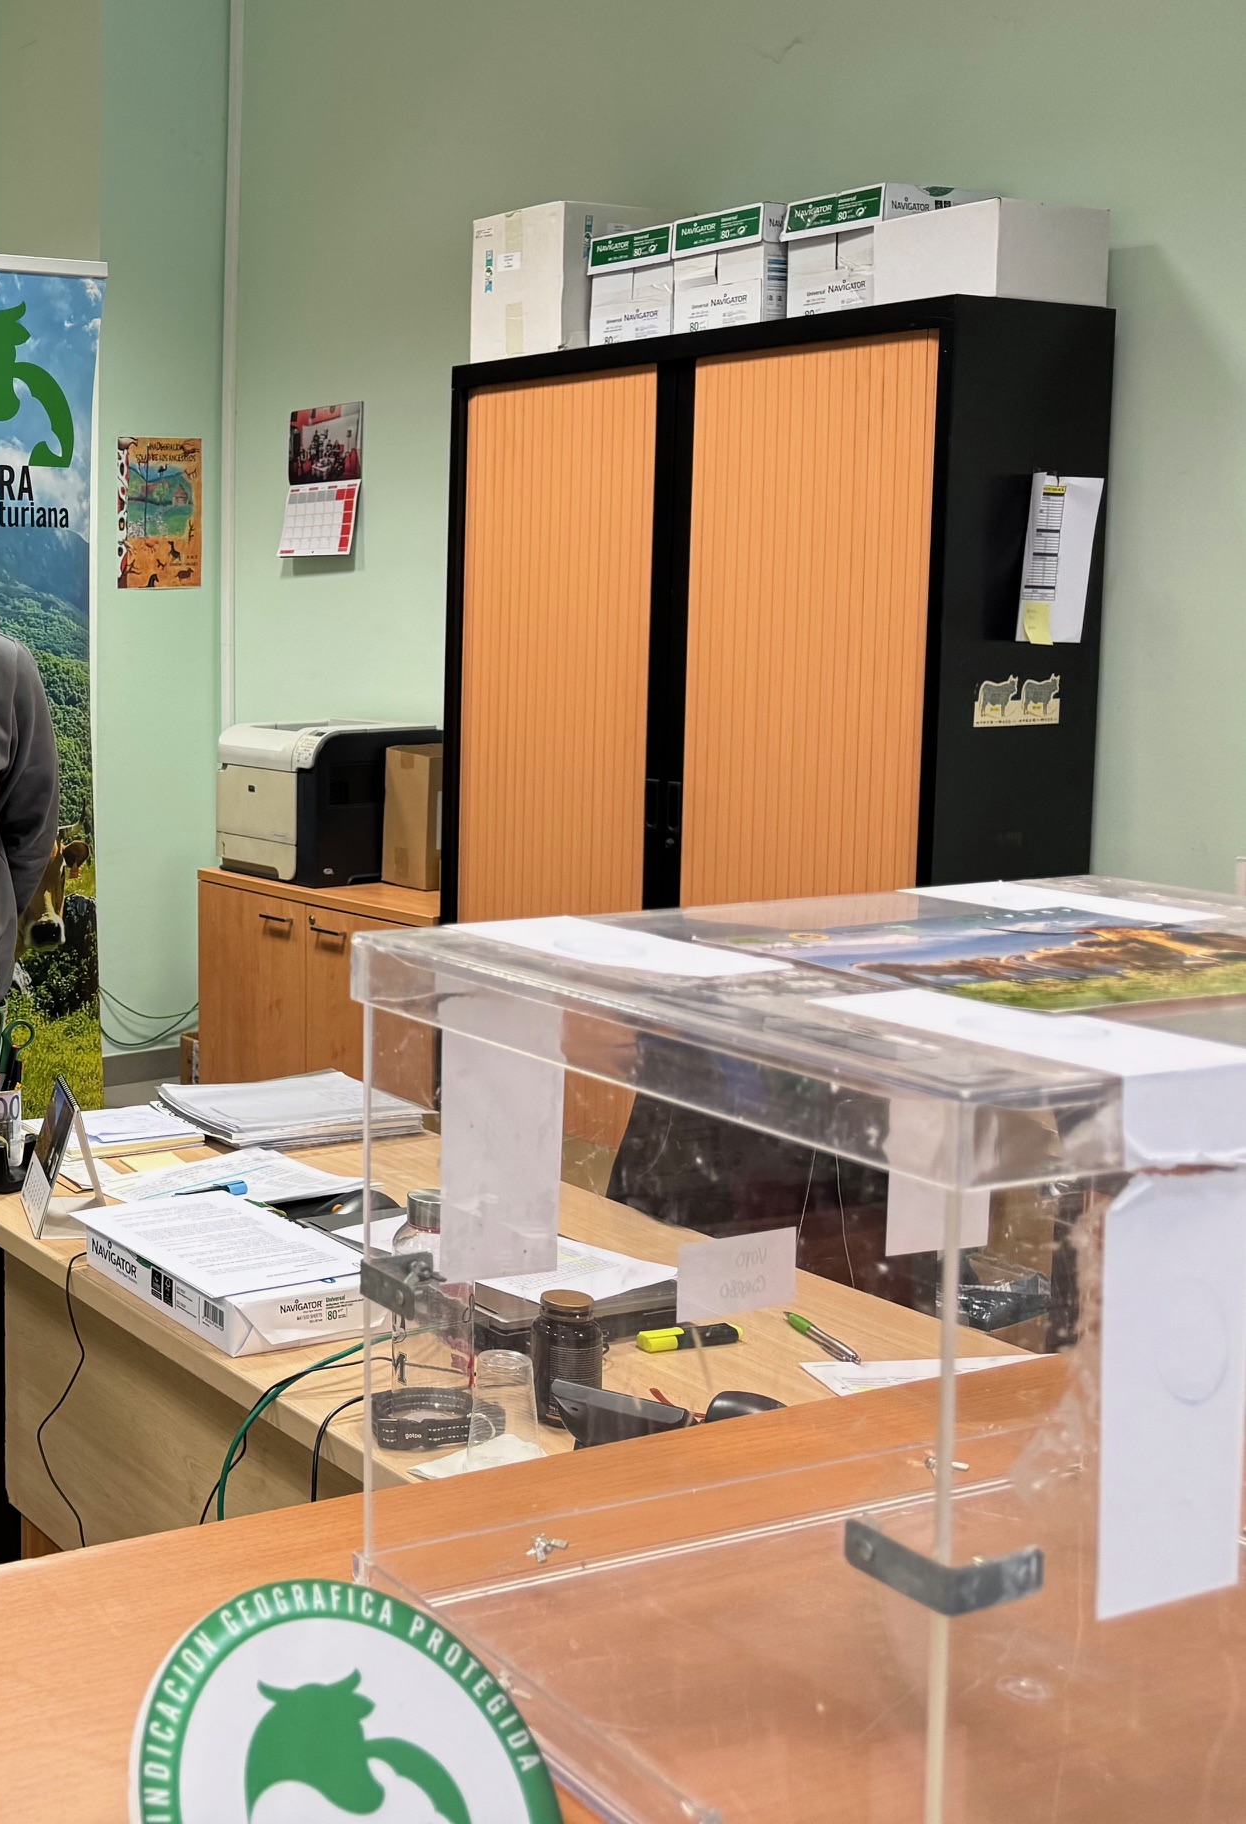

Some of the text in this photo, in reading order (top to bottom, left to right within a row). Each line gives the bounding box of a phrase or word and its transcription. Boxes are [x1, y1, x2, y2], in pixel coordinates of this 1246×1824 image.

[794, 205, 833, 218] NAVIGATOR
[891, 199, 930, 212] NAVIGATOR
[837, 211, 847, 221] 80
[681, 223, 716, 236] NAVIGATOR
[721, 230, 730, 239] 80
[596, 241, 630, 253] NAVIGATOR
[827, 280, 866, 294] NAVIGATOR
[710, 295, 748, 307] NAVIGATOR
[623, 310, 659, 322] NAVIGATOR
[91, 1238, 138, 1279] NAVIGATOR
[279, 1300, 323, 1314] NAVIGATOR
[327, 1310, 338, 1321] 80
[220, 1582, 395, 1637] GEOGRAFICA
[408, 1614, 541, 1774] PROTEGIDA
